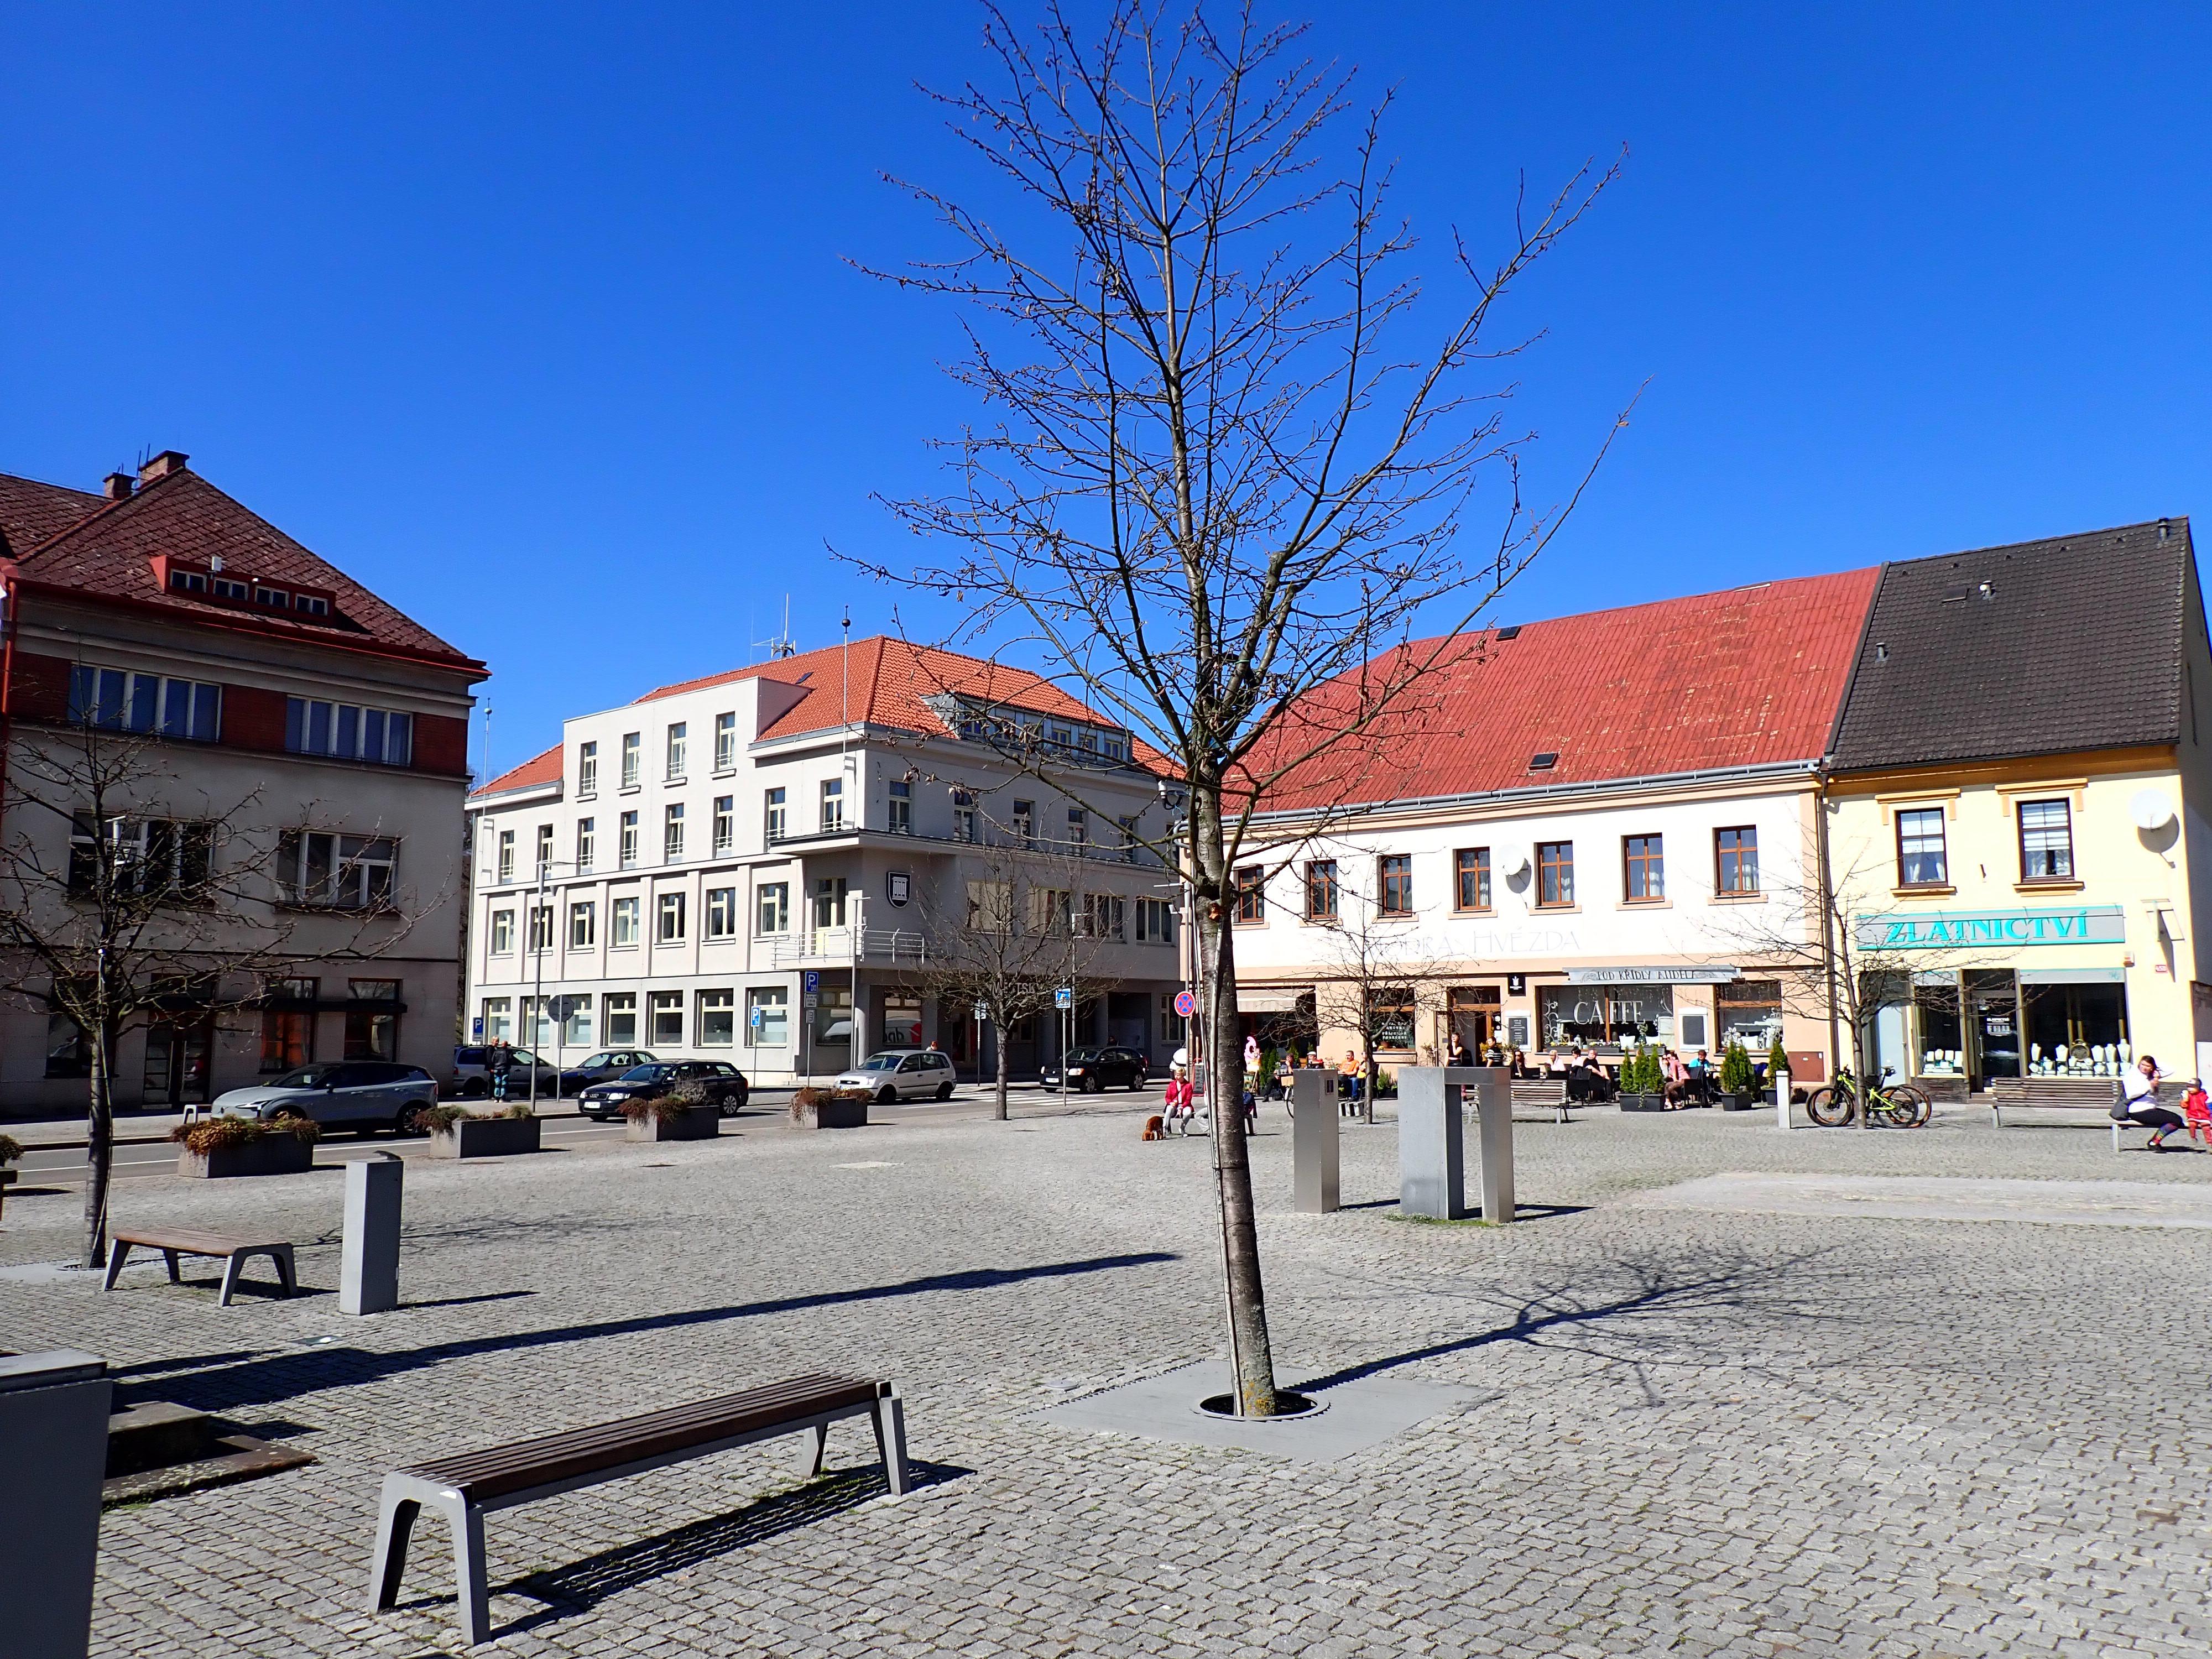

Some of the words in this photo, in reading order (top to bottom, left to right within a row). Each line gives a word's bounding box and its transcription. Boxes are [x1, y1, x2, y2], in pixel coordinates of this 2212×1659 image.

[1885, 910, 2088, 942] ZLATNICTVÍ
[808, 974, 816, 987] P
[1598, 971, 1615, 980] POD
[1619, 969, 1651, 980] KŘÍDLY
[753, 1008, 759, 1021] P
[1574, 1000, 1646, 1025] CAFFE
[476, 1019, 482, 1029] P
